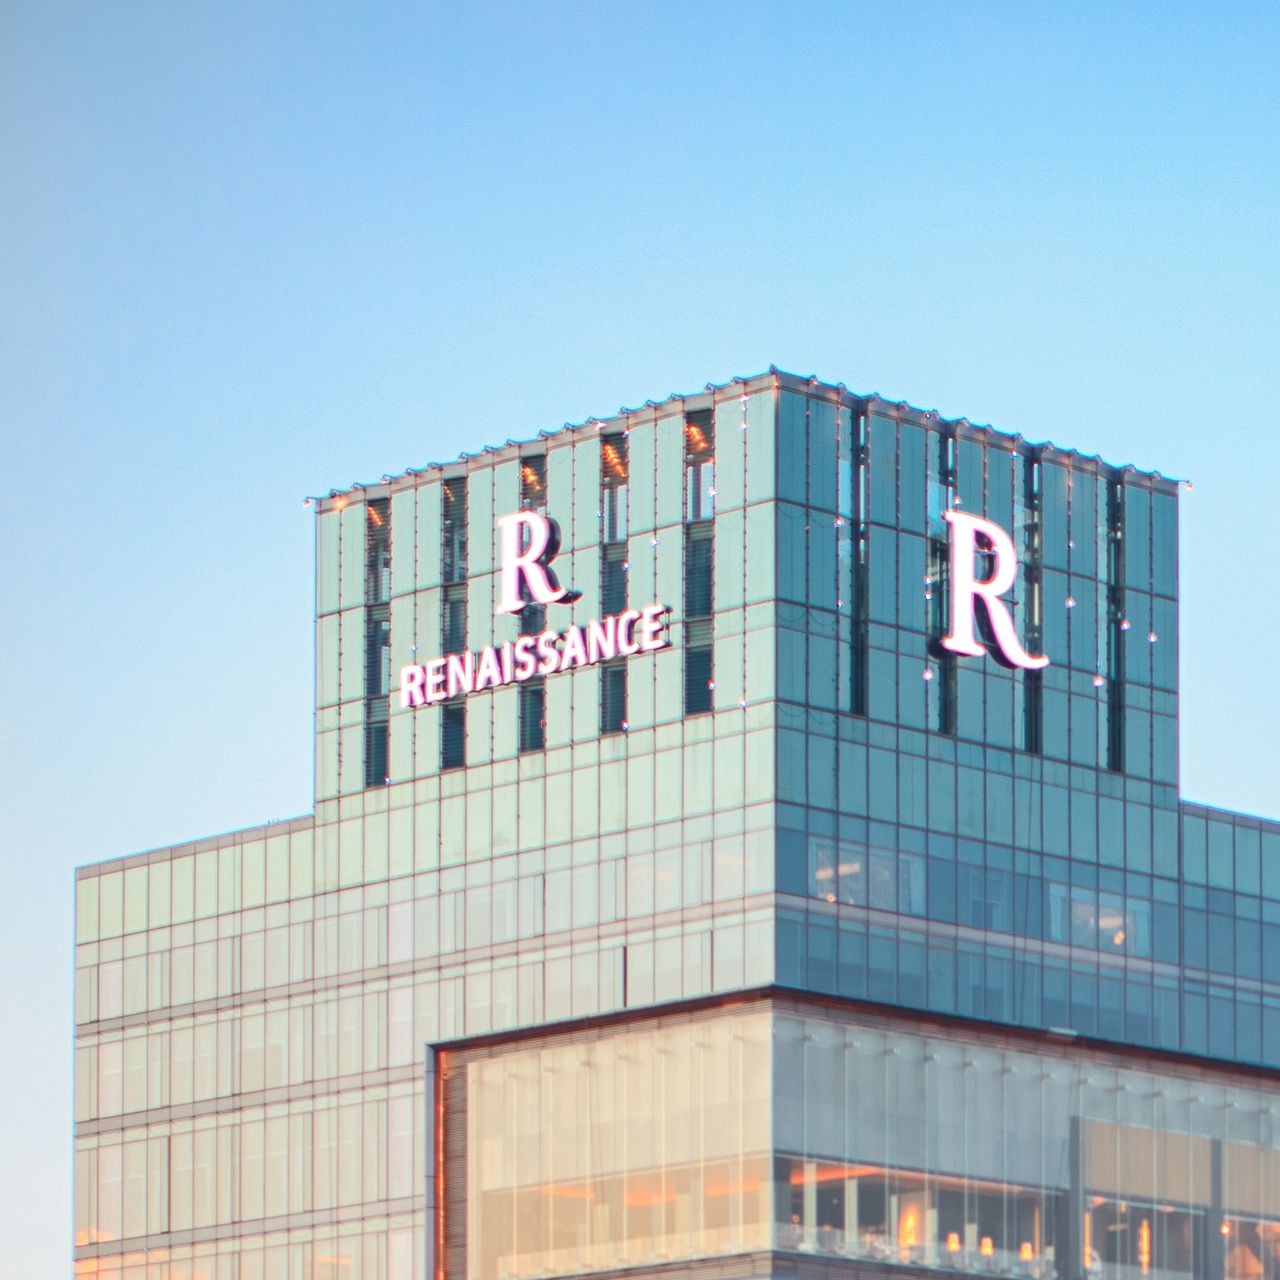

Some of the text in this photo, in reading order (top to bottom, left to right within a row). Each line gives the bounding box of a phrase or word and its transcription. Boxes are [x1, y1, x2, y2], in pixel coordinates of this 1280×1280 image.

[496, 509, 574, 615] R
[941, 509, 1050, 670] R
[399, 602, 670, 709] RENAISSANCE
